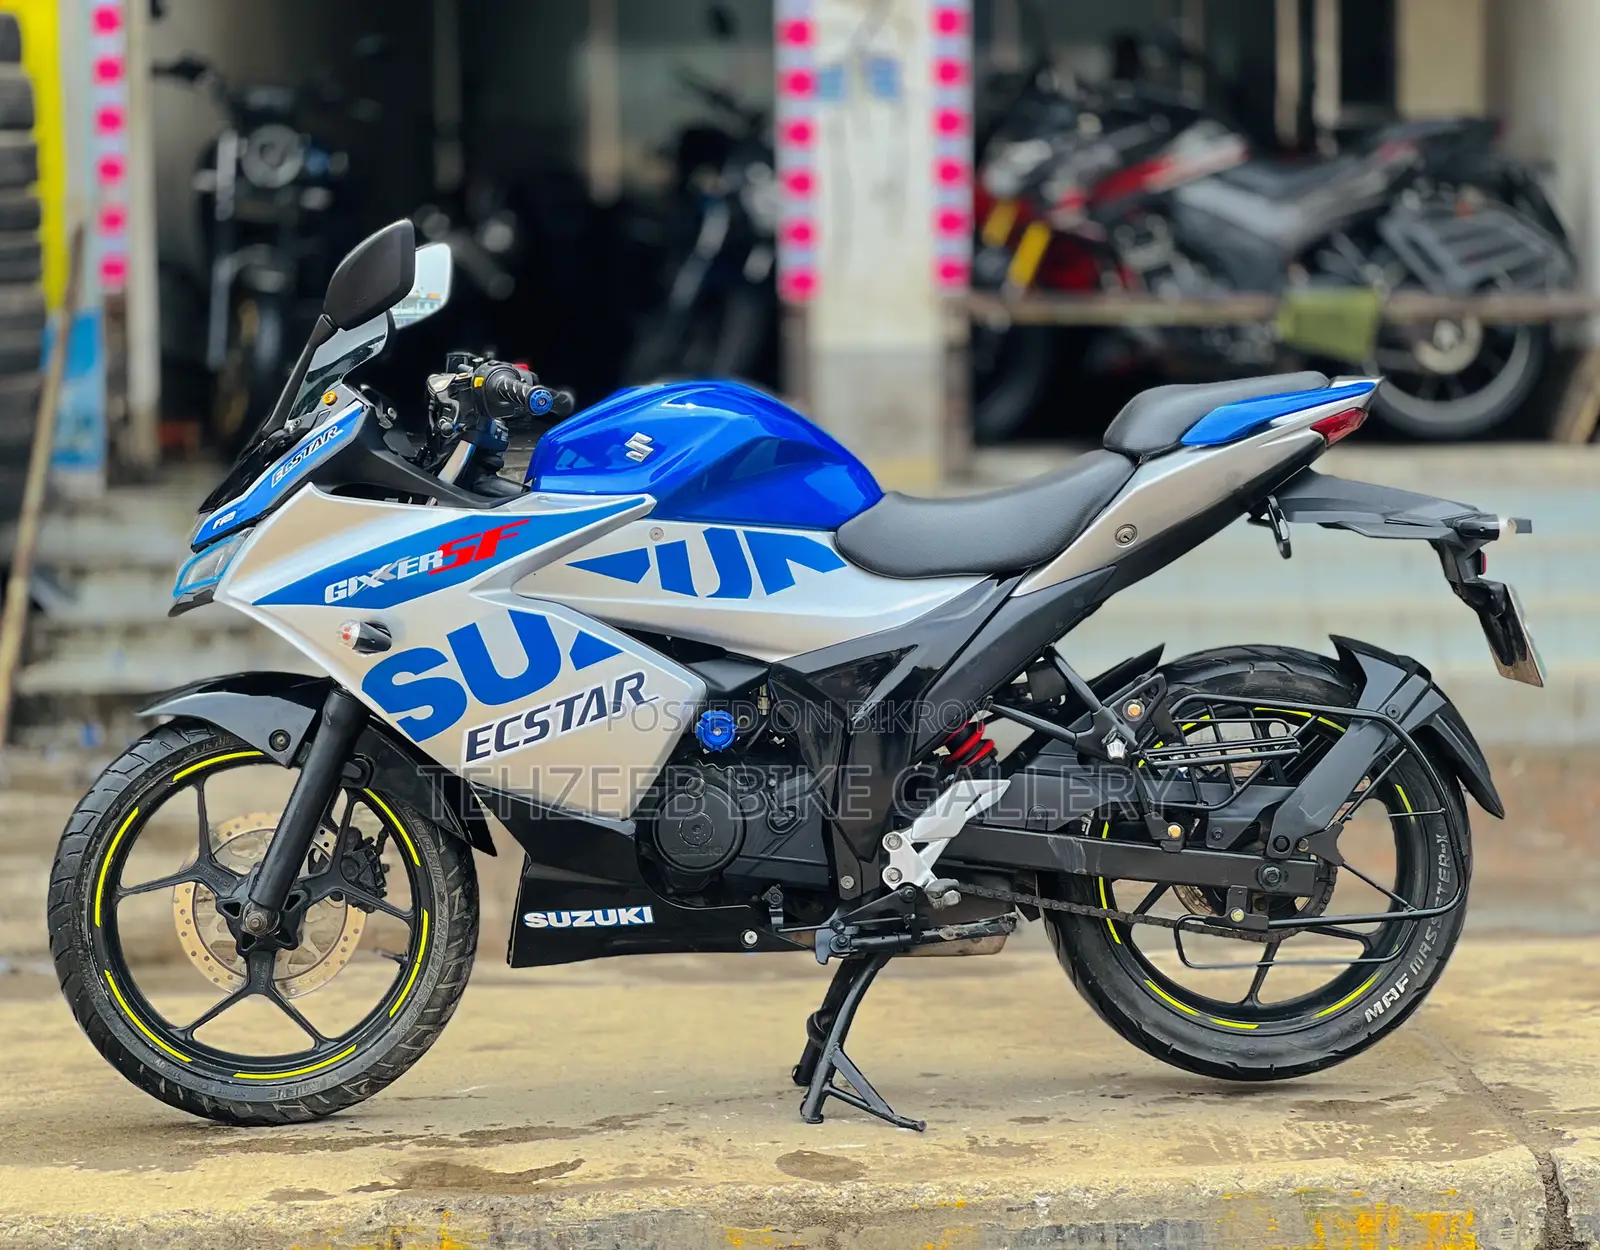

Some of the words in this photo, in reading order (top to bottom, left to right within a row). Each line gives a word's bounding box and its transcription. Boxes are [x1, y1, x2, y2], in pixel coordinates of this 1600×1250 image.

[270, 425, 344, 489] ECSTAR
[324, 549, 444, 604] GIXXER
[463, 671, 660, 765] ECSTAR
[523, 904, 656, 928] SUZUKI
